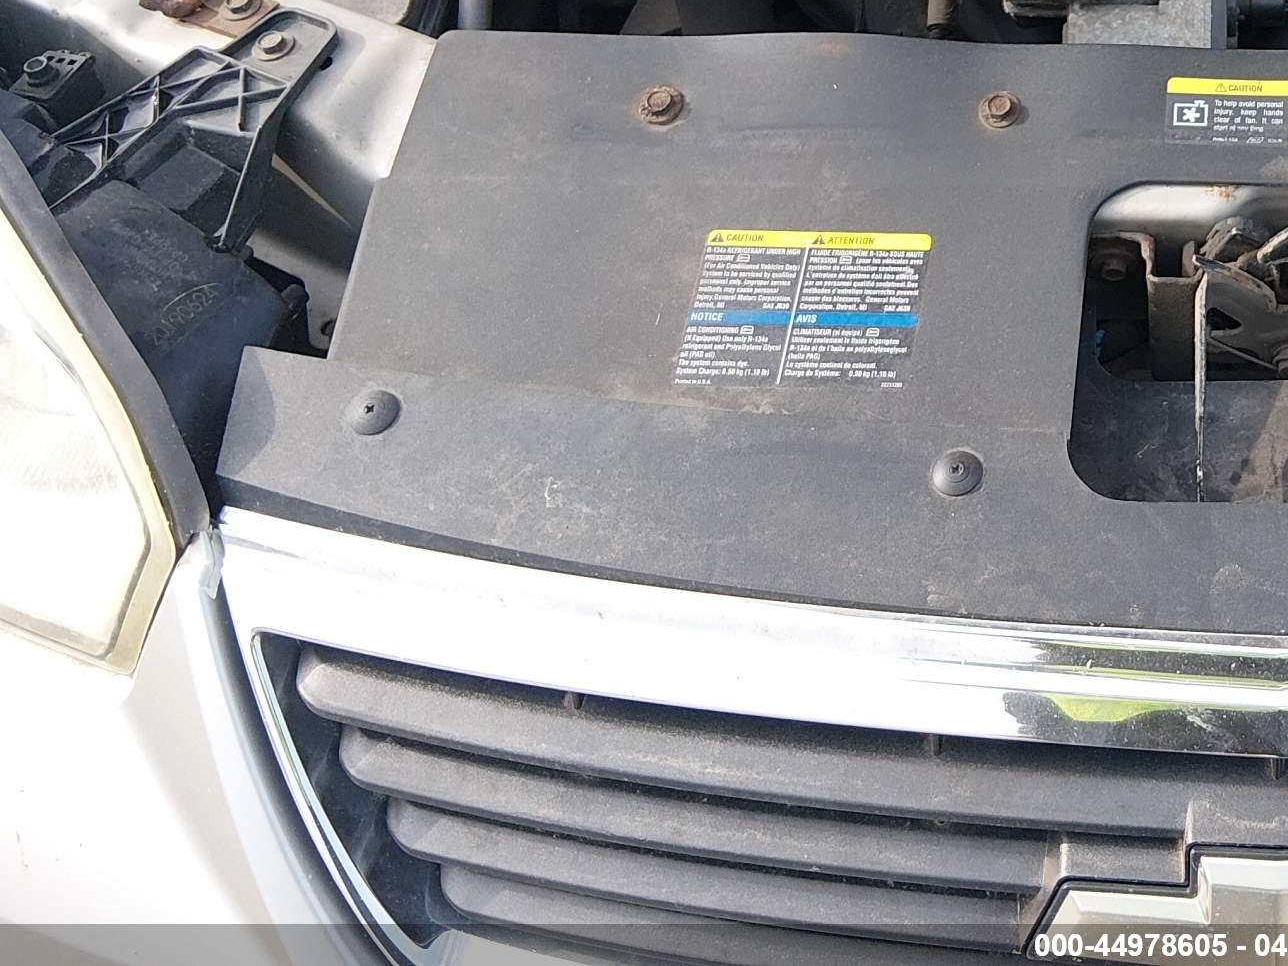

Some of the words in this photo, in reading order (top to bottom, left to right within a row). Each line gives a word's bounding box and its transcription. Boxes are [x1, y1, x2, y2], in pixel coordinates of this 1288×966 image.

[1228, 84, 1263, 93] CAUTION
[1257, 100, 1284, 108] personal
[1241, 108, 1257, 116] keep
[726, 233, 764, 242] CAUTION
[827, 236, 875, 245] ATTENTION
[691, 313, 724, 321] NOTICE
[796, 315, 817, 323] AVIS
